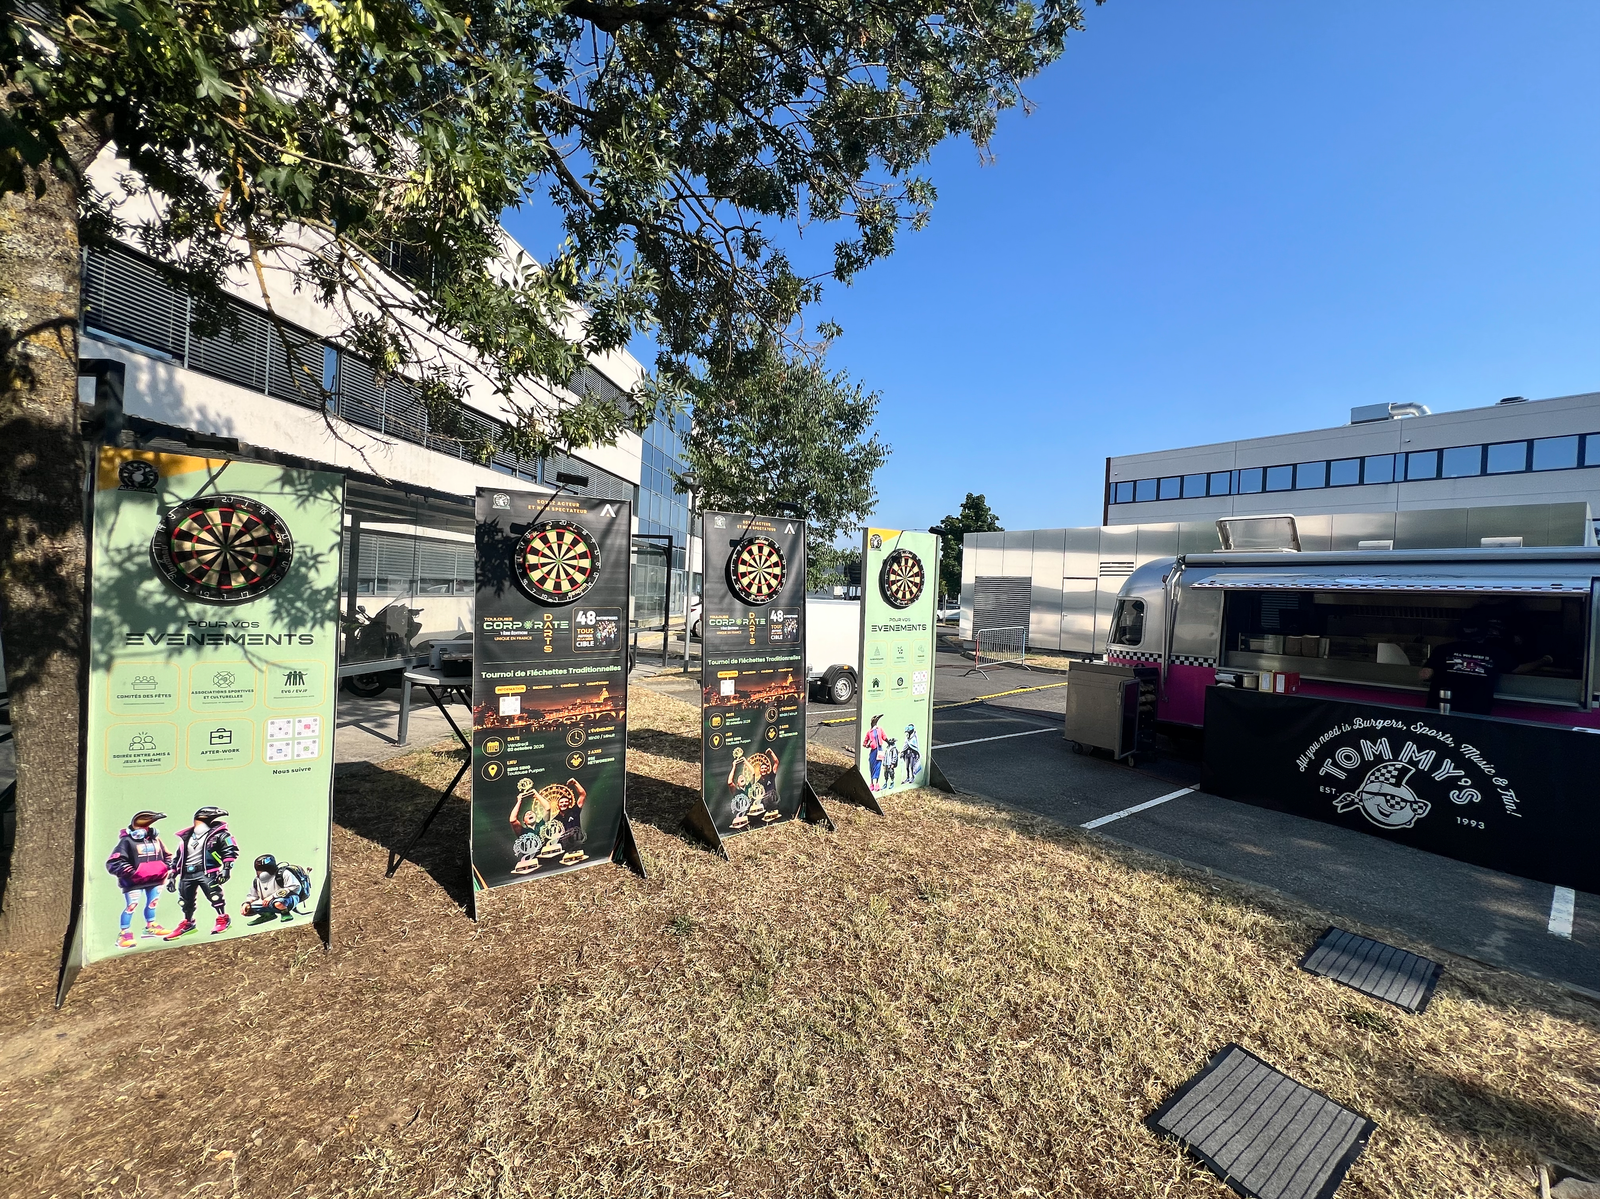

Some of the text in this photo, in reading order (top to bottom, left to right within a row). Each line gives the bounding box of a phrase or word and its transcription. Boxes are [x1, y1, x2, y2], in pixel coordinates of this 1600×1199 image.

[576, 611, 596, 626] 48
[770, 610, 784, 622] 48
[187, 620, 260, 628] POUR VOS
[871, 624, 927, 632] EVENEMENTS
[126, 632, 314, 646] EVENEMENTS
[544, 614, 553, 652] DARTS
[481, 670, 514, 678] Tournoi
[526, 669, 568, 677] Fléchettes
[568, 665, 622, 674] Traditionnelles
[1296, 717, 1522, 818] All you need is Burgers, Sports, Music & Fun!
[1318, 737, 1482, 805] TOMMY'S
[1319, 786, 1340, 796] EST.
[1456, 816, 1485, 830] 1993
